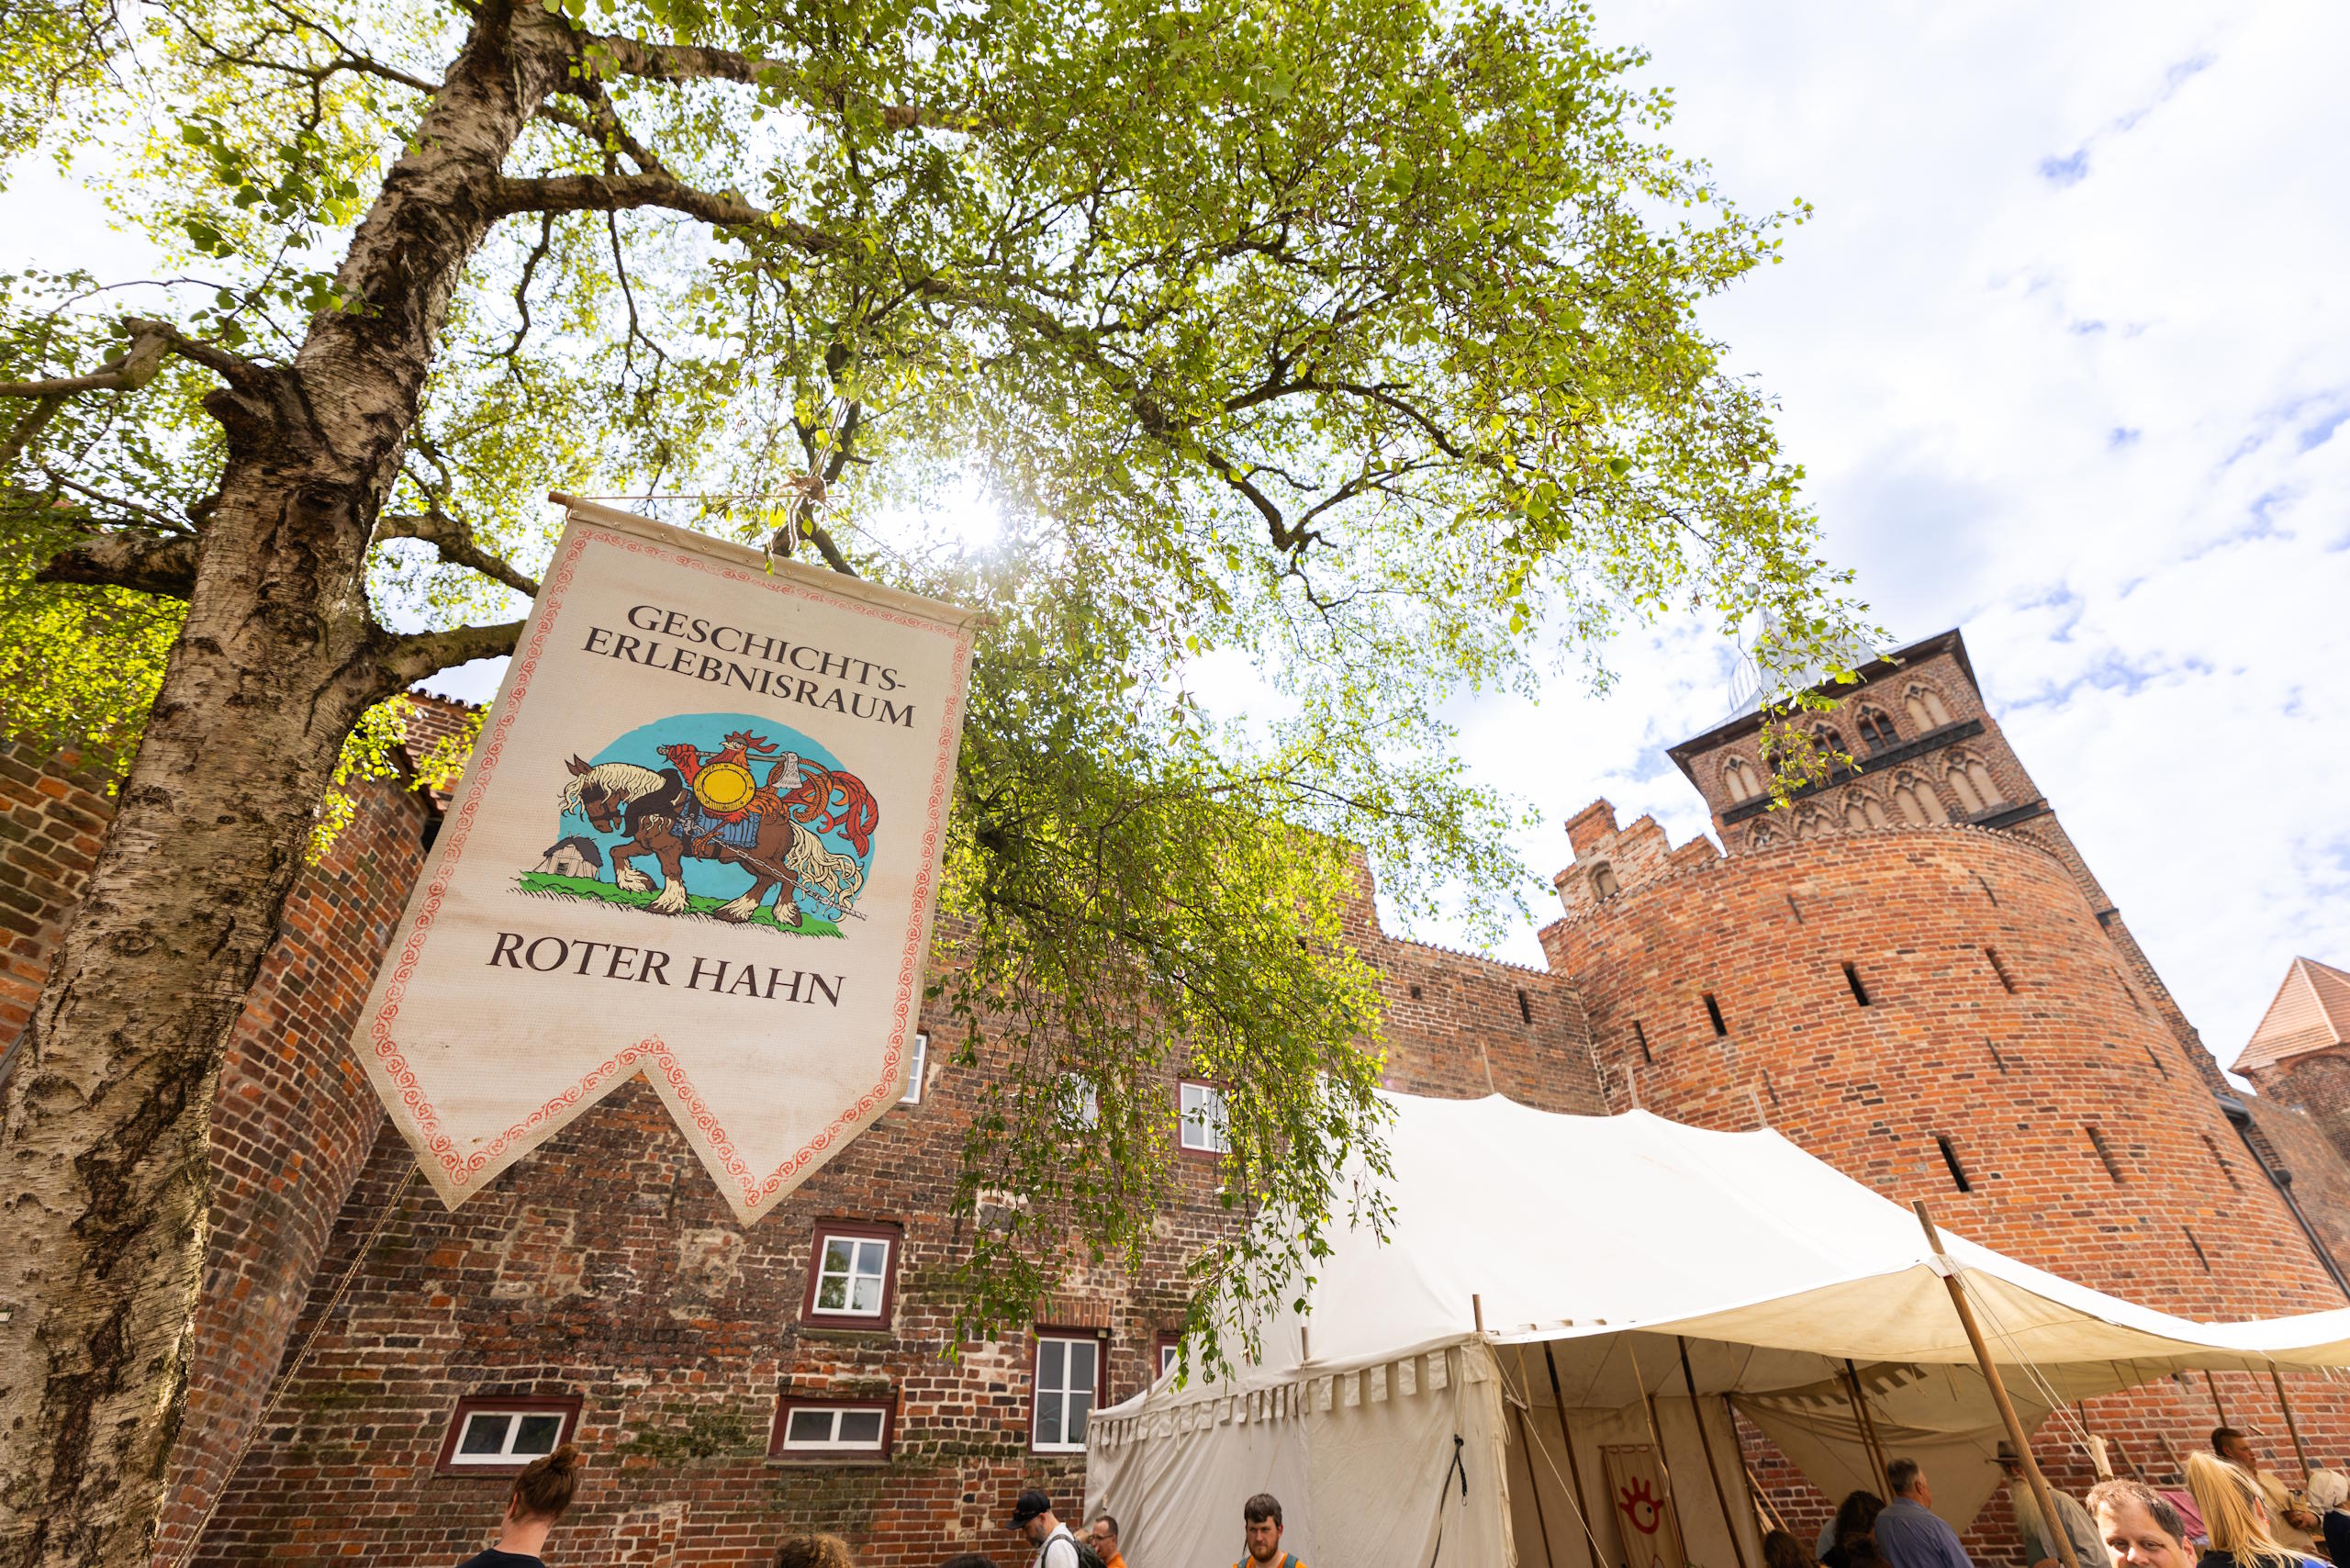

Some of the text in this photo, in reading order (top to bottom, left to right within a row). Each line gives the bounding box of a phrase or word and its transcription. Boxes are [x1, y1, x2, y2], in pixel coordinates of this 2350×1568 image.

[581, 626, 916, 728] ERLEBNISRAUM
[627, 605, 907, 691] GESCHICHTS-
[486, 932, 846, 1008] ROTER HAHN
